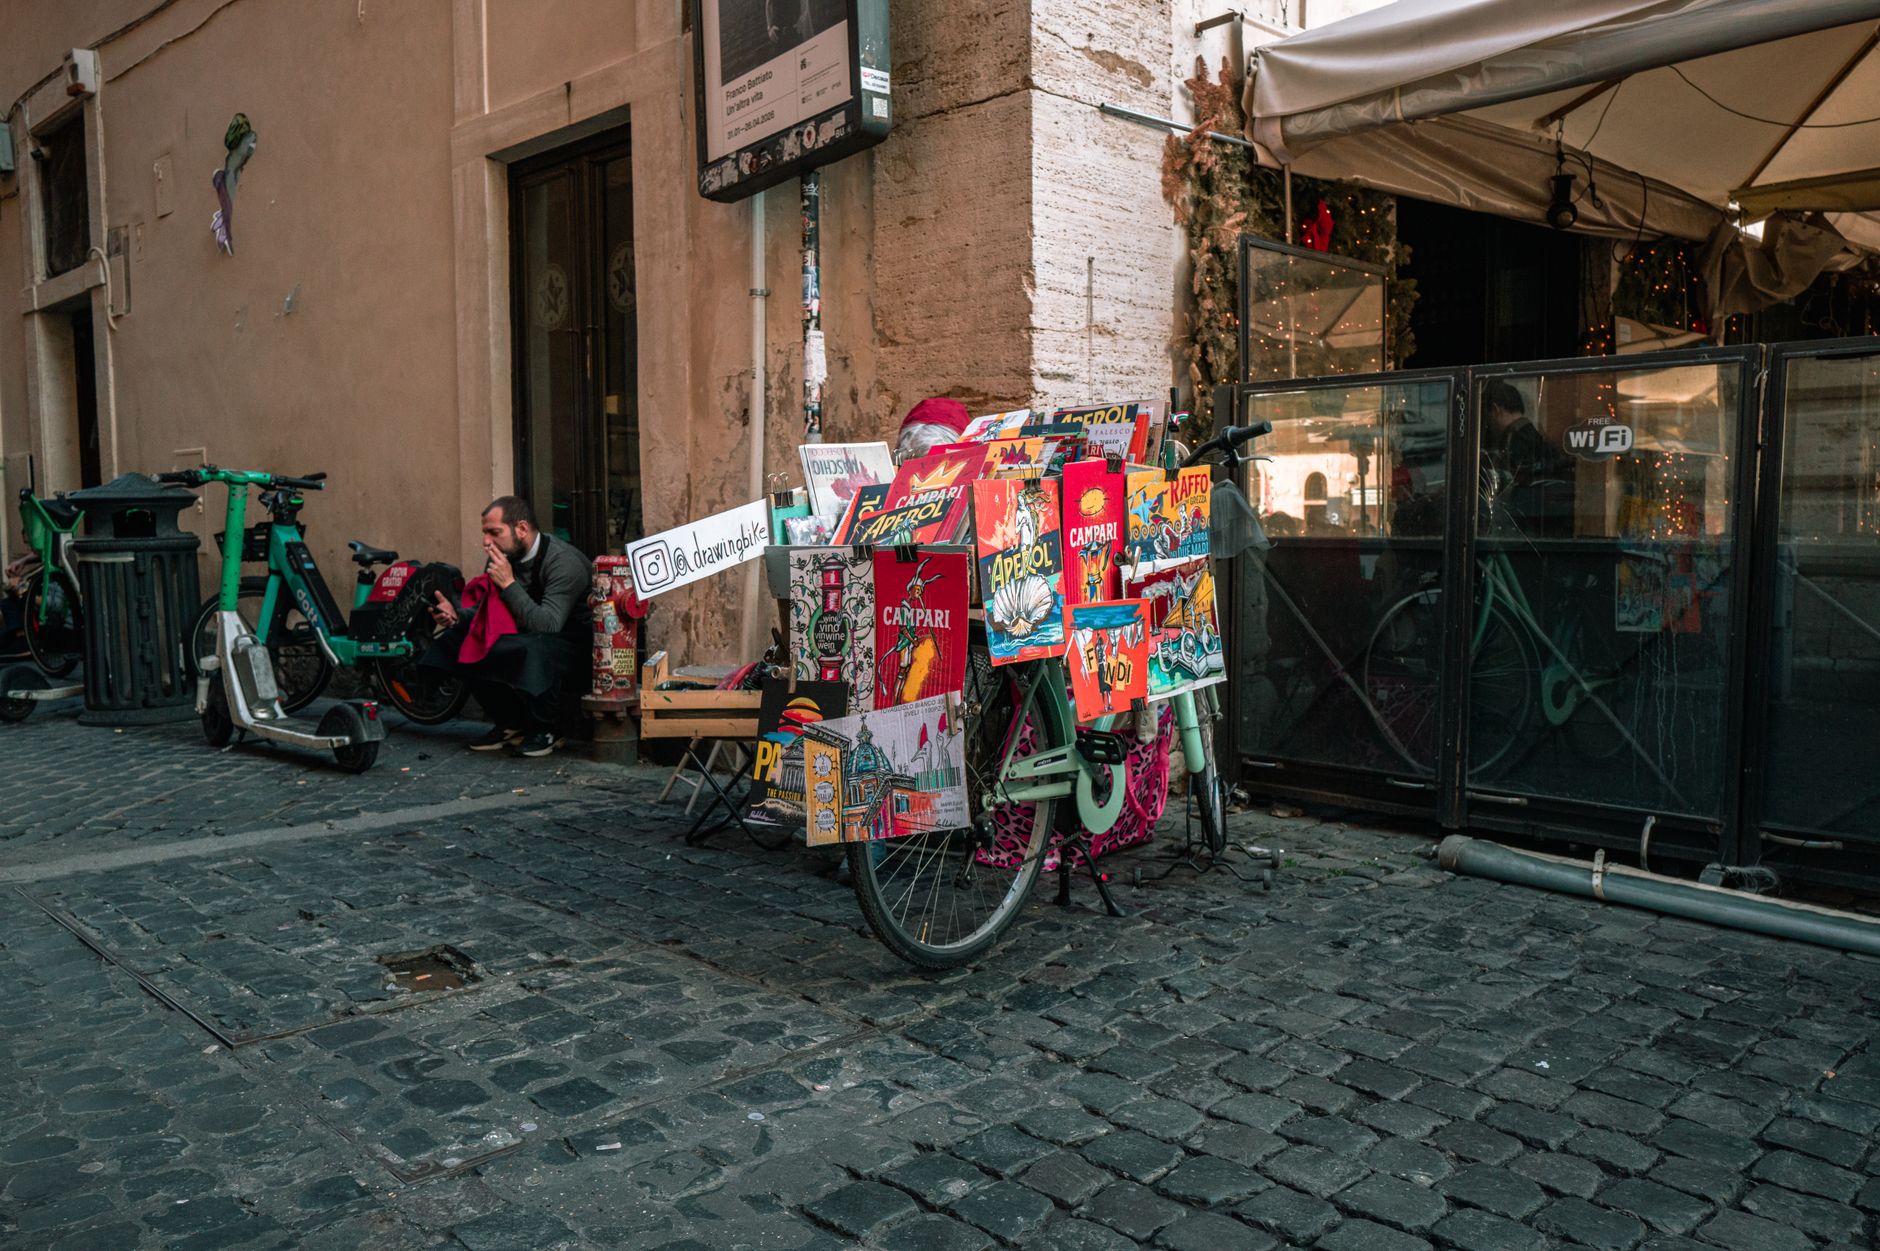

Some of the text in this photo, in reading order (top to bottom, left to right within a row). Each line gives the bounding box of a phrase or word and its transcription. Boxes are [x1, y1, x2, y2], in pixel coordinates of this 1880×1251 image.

[726, 70, 773, 101] Franco Battiato
[751, 90, 763, 103] vita
[1587, 417, 1610, 426] FREE
[812, 458, 859, 475] MASCHIO
[895, 483, 966, 510] CAMPARI
[1170, 472, 1208, 508] RAFFO
[859, 500, 944, 543] APEROL
[1070, 521, 1118, 548] CAMPARI
[389, 567, 408, 577] PROVA
[991, 544, 1054, 593] APEROL
[296, 588, 318, 627] dott
[883, 606, 951, 630] CAMPARI
[767, 787, 777, 798] THE
[777, 790, 801, 801] PASSION
